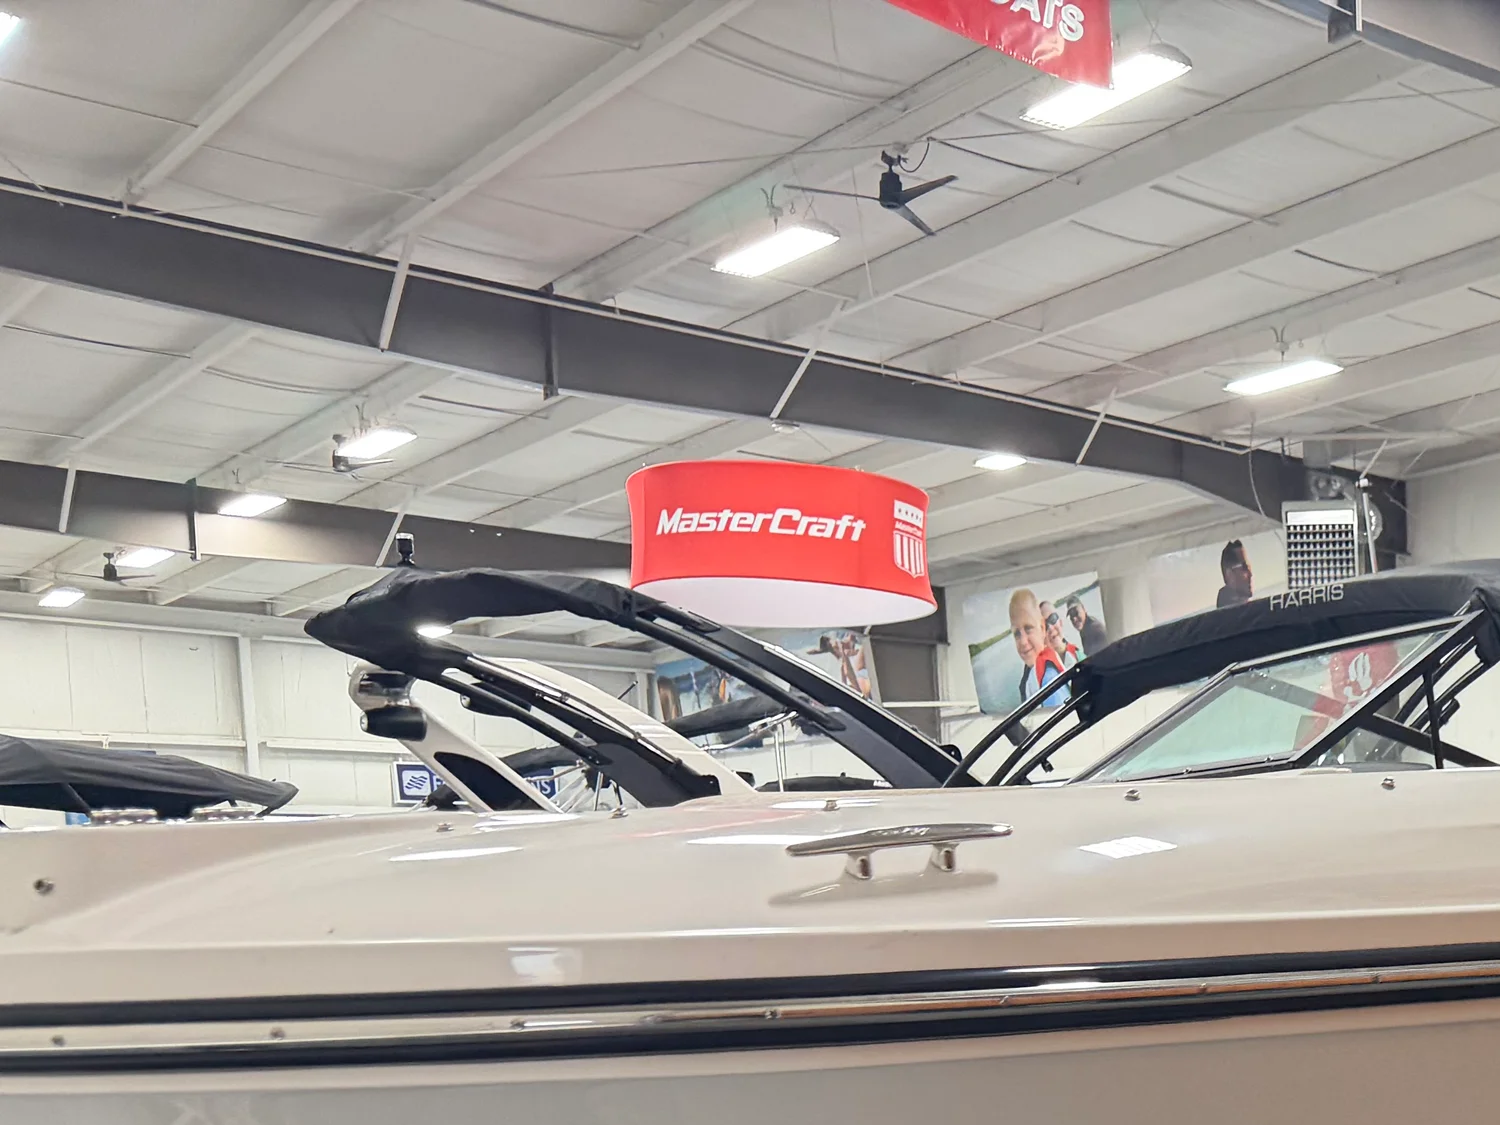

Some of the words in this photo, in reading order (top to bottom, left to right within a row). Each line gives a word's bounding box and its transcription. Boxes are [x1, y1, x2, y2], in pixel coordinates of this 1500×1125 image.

[990, 0, 1085, 42] ATS
[656, 507, 867, 542] MasterCraft
[1269, 583, 1345, 612] HARRIS
